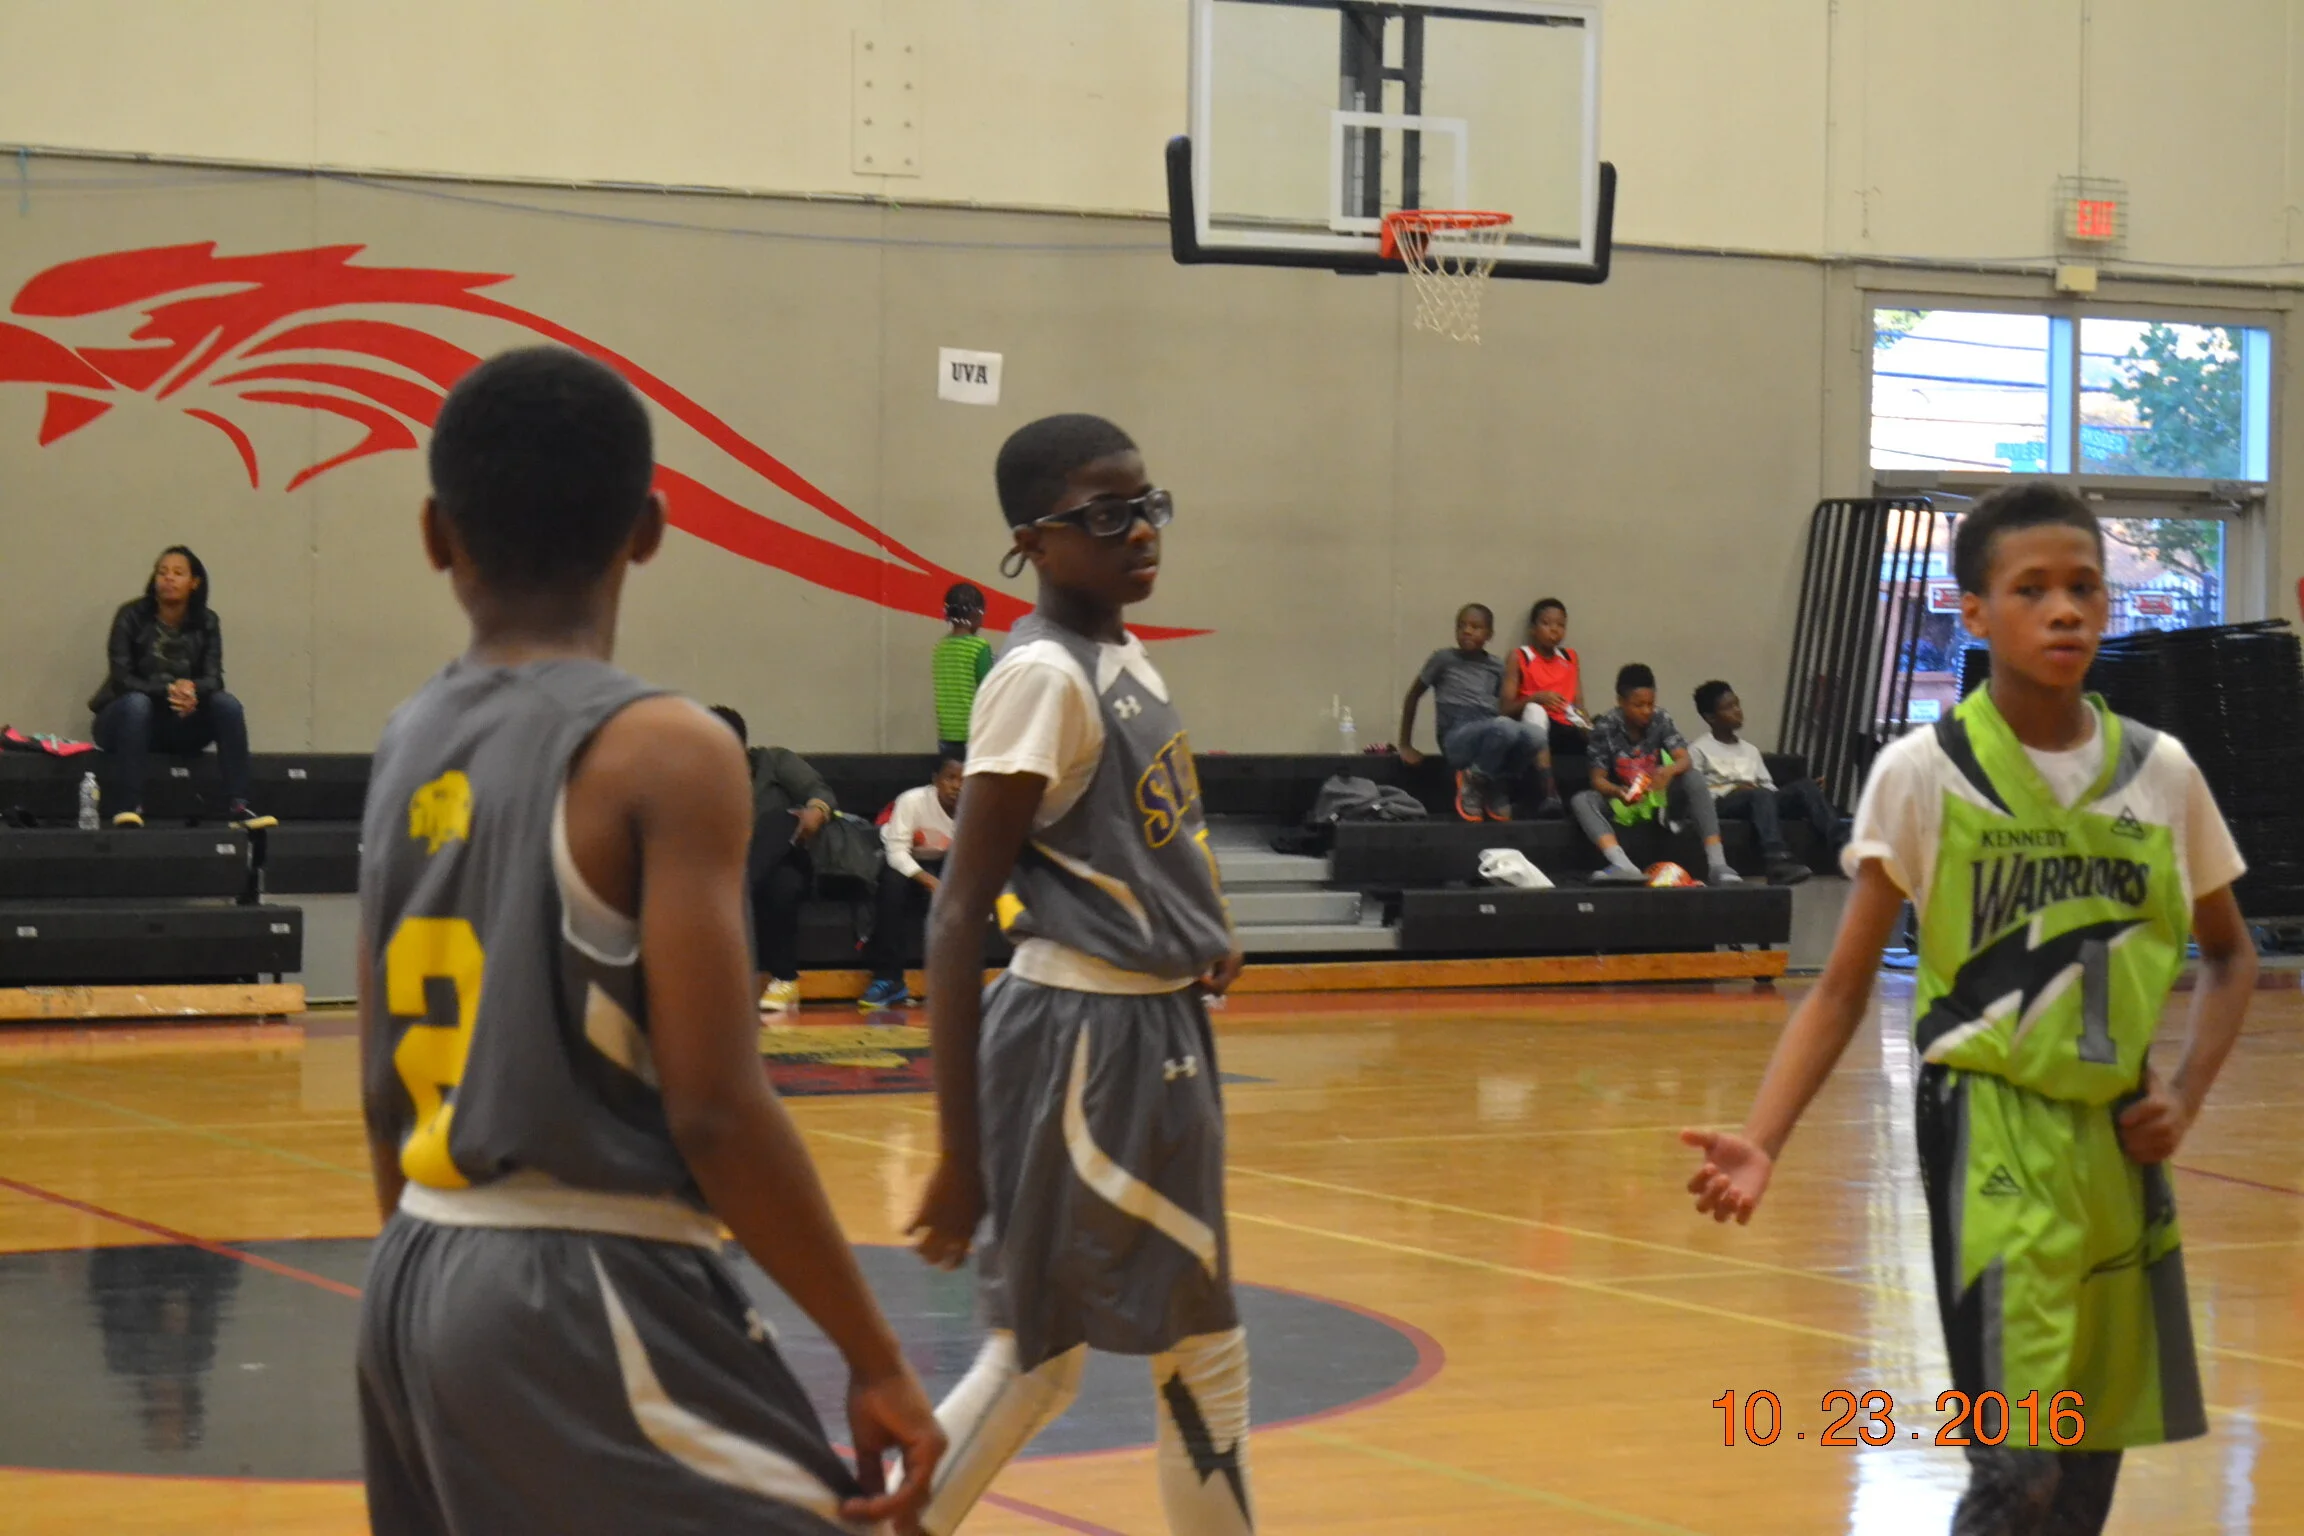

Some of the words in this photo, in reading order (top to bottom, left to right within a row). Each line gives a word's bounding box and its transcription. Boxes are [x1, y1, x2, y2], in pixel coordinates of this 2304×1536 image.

[951, 361, 988, 384] UVA
[1981, 829, 2069, 847] KENNEDY
[1970, 853, 2150, 950] WARRIORS
[2076, 937, 2118, 1065] 1
[386, 917, 485, 1188] 2
